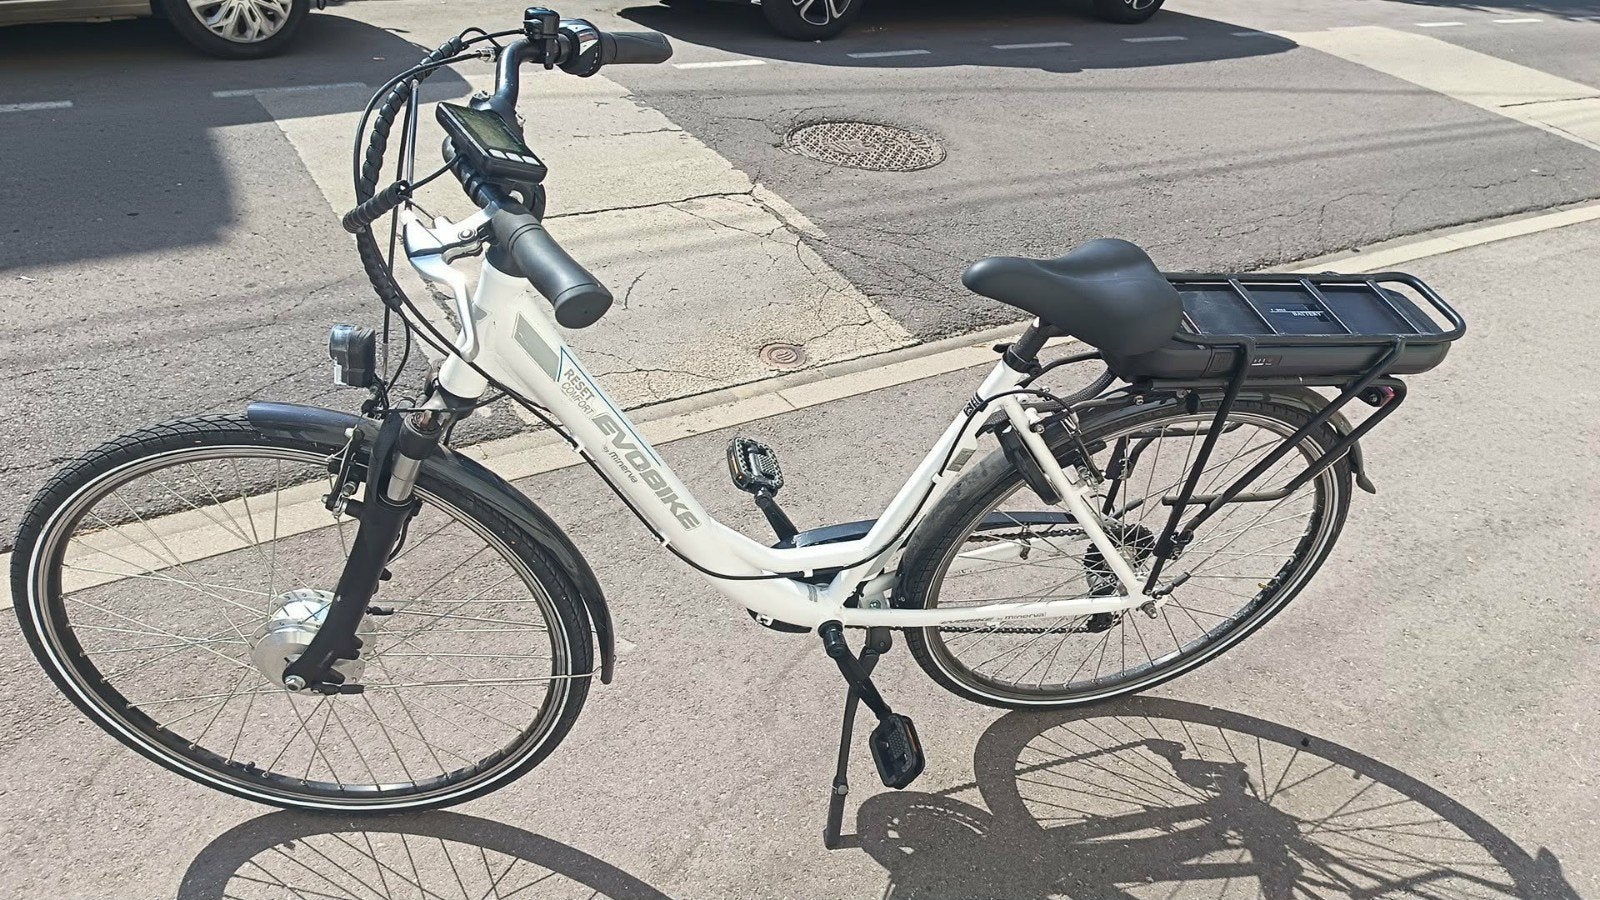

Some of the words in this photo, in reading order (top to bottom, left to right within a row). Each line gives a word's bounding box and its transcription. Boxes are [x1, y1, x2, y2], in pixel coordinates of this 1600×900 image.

[561, 382, 595, 415] COMFORT
[564, 368, 595, 401] RESET
[592, 414, 701, 530] EVOBIKE
[609, 451, 639, 483] minerva
